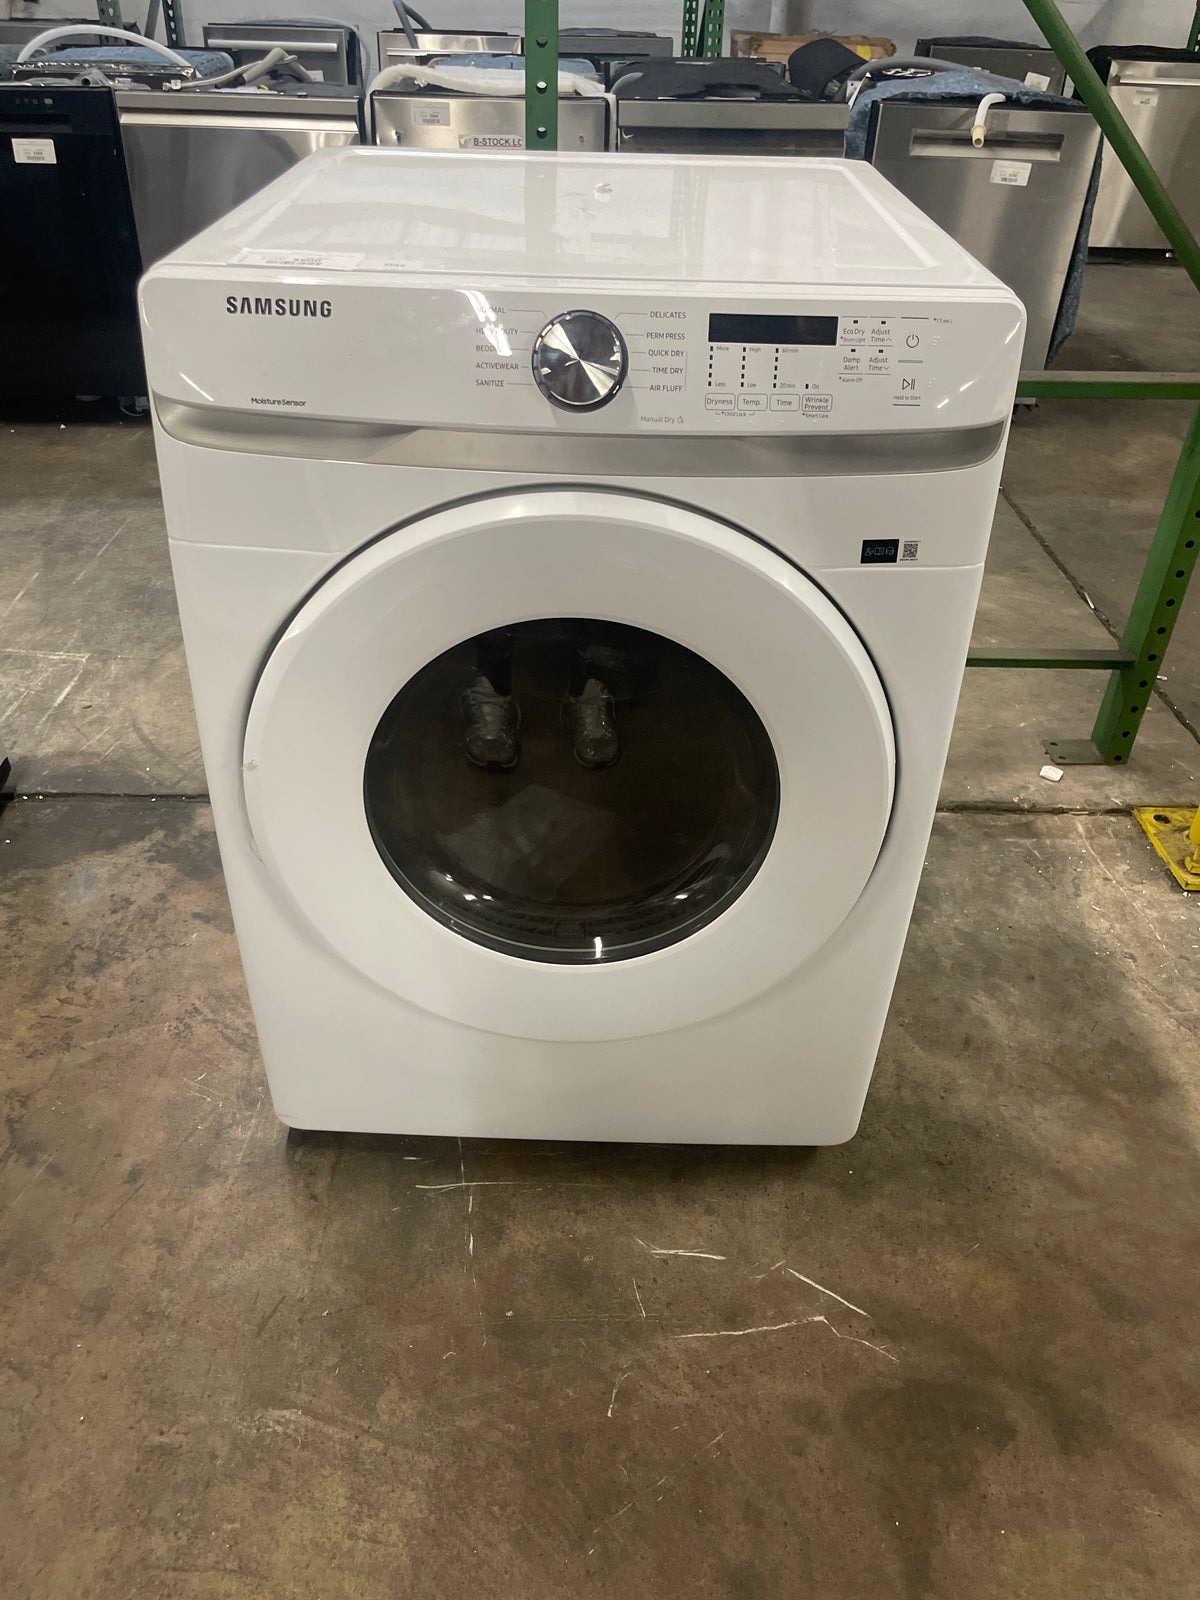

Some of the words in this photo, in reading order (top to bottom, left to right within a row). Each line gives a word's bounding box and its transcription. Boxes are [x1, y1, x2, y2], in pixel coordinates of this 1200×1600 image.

[473, 137, 511, 147] B-STOCK
[226, 295, 332, 319] SAMSUNG
[650, 311, 687, 319] DELICATES
[646, 332, 665, 340] PERM
[665, 332, 686, 340] PRESS
[854, 328, 866, 336] Dry
[871, 328, 891, 336] Adjust
[648, 349, 670, 358] QUICK
[670, 349, 685, 357] DRY
[843, 356, 861, 364] Damp
[868, 356, 889, 365] Adjust
[475, 362, 519, 370] ACTIVEWEAR
[652, 366, 669, 375] TIME
[669, 367, 684, 375] DRY
[843, 363, 859, 371] Alert
[475, 379, 505, 387] SANITIZE
[649, 384, 661, 393] AIR
[662, 385, 683, 393] FLUFF
[706, 397, 734, 408] Dryness
[742, 398, 762, 408] Temp.
[804, 396, 830, 405] Wrinkle
[804, 403, 829, 412] Prevent
[640, 414, 663, 424] Manual
[664, 415, 676, 426] Dry
